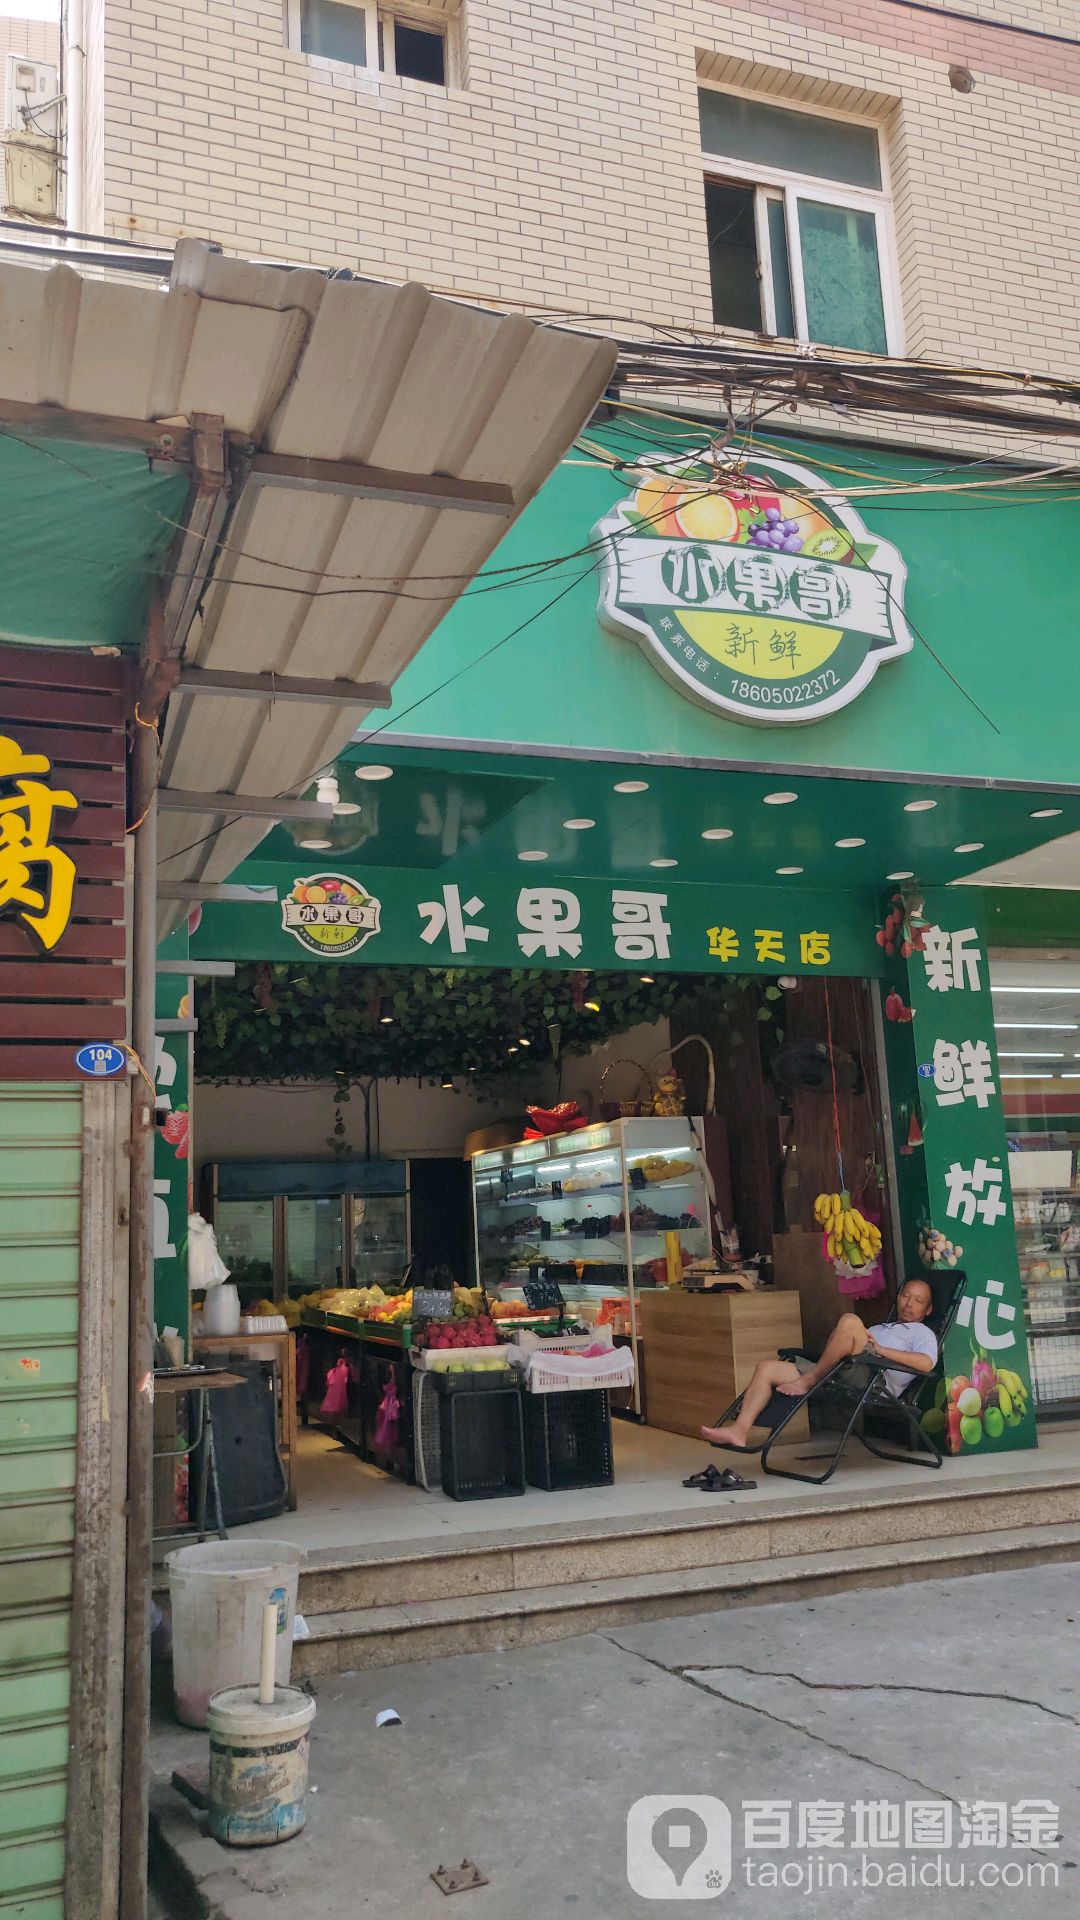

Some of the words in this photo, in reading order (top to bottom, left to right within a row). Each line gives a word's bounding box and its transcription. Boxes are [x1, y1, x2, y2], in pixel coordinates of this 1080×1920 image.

[662, 545, 850, 621] 水果哥
[724, 622, 802, 670] 新鲜
[730, 669, 841, 704] 18605022372
[300, 905, 364, 923] 水果哥
[419, 884, 672, 961] 水果哥
[705, 926, 832, 966] 华天店
[89, 1048, 113, 1061] 104
[921, 924, 1016, 1350] 新鲜放心
